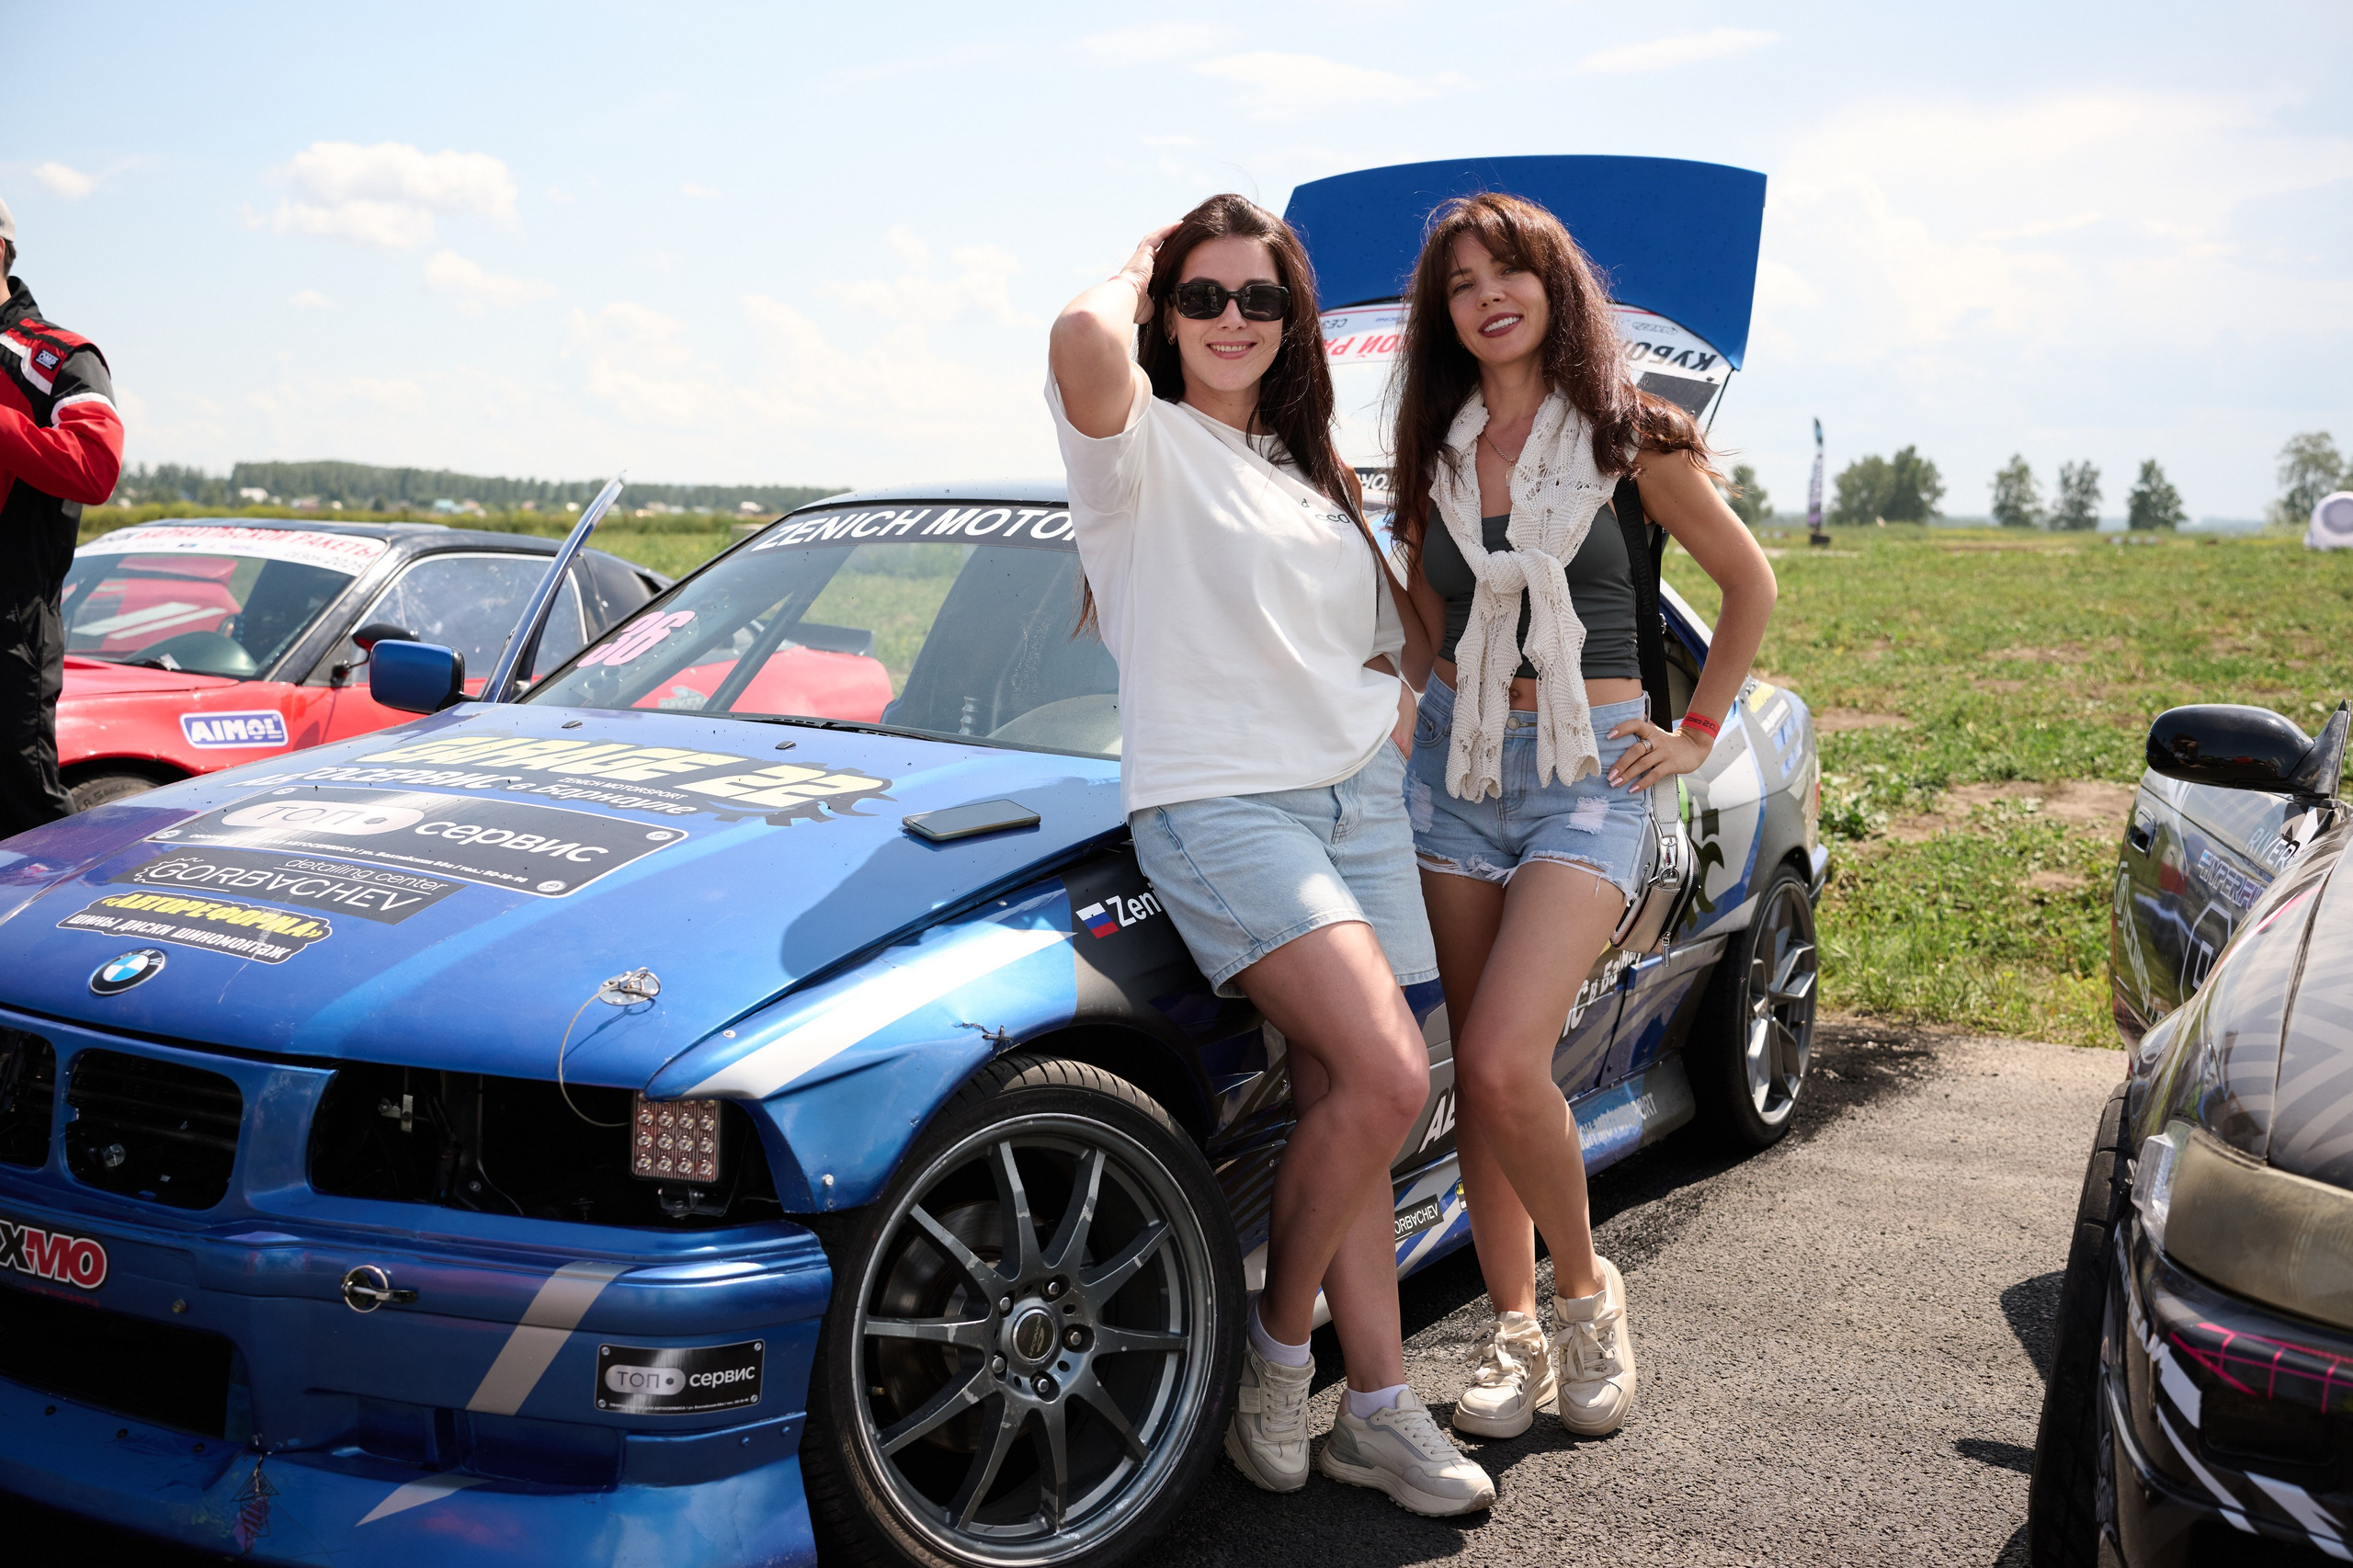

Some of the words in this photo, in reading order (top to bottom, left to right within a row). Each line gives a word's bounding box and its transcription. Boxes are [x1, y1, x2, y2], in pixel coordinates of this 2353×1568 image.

[38, 351, 58, 368] OMP
[750, 508, 925, 552] ZENICH
[920, 507, 1075, 540] MOTO
[577, 610, 696, 668] 36
[191, 718, 283, 742] AIMOL
[355, 736, 748, 781] GARAGE
[672, 765, 883, 807] 22
[529, 783, 698, 814] Барнауле
[557, 777, 600, 790] ZENICH
[601, 781, 688, 801] MOTORSPORT
[257, 806, 369, 826] ТОП
[415, 821, 609, 862] сервис
[286, 858, 377, 884] detailing
[382, 870, 448, 892] center
[617, 1370, 660, 1389] ТОП
[689, 1366, 756, 1389] сервис
